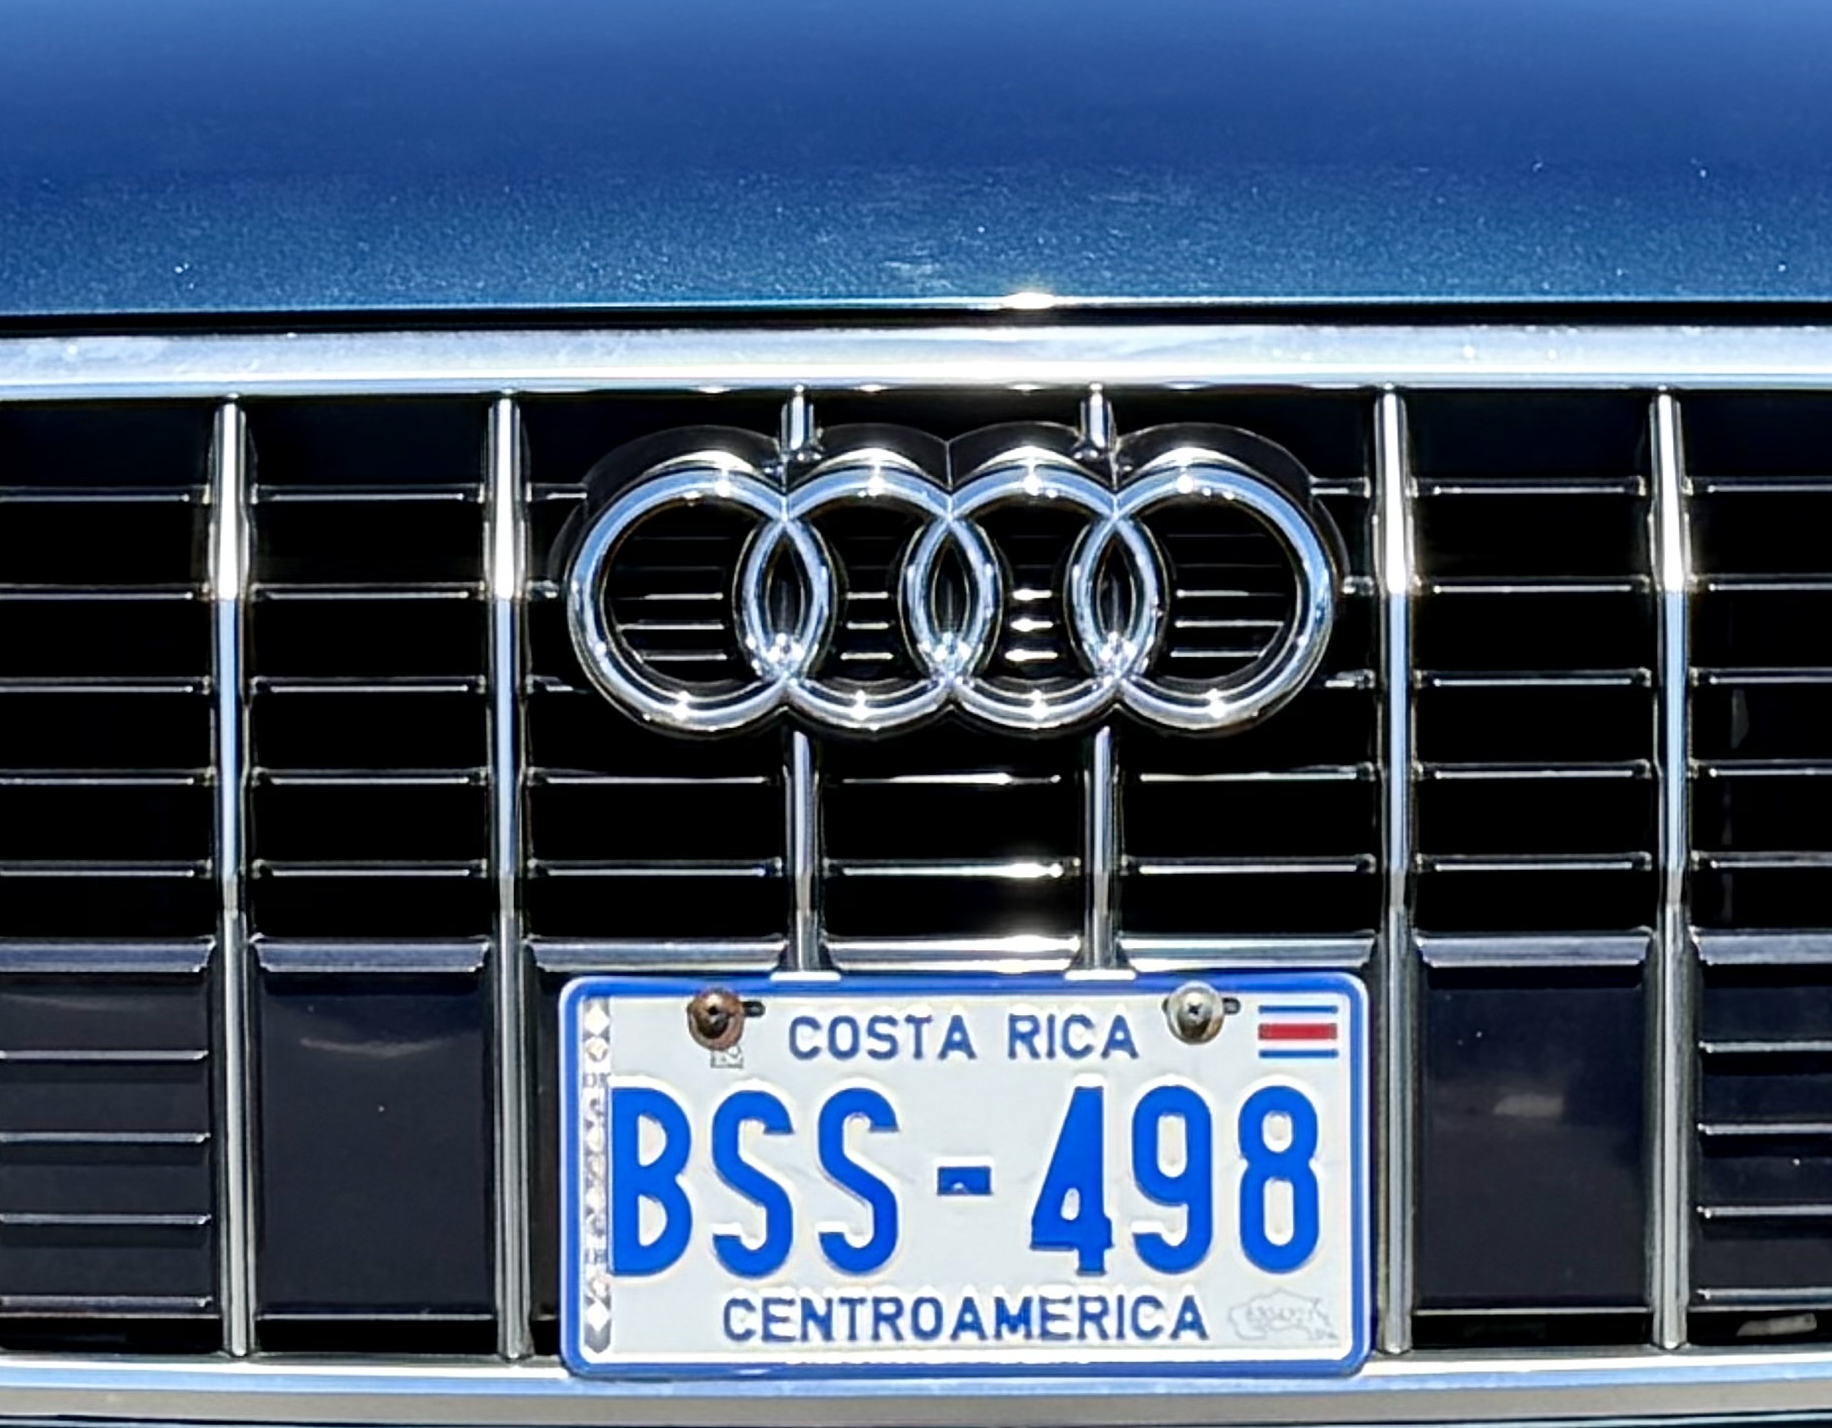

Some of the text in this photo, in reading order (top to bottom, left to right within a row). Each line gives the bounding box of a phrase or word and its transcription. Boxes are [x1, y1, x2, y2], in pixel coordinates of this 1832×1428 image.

[787, 1013, 1140, 1062] COSTA RICA
[722, 1295, 1210, 1344] CENTROAMERICA
